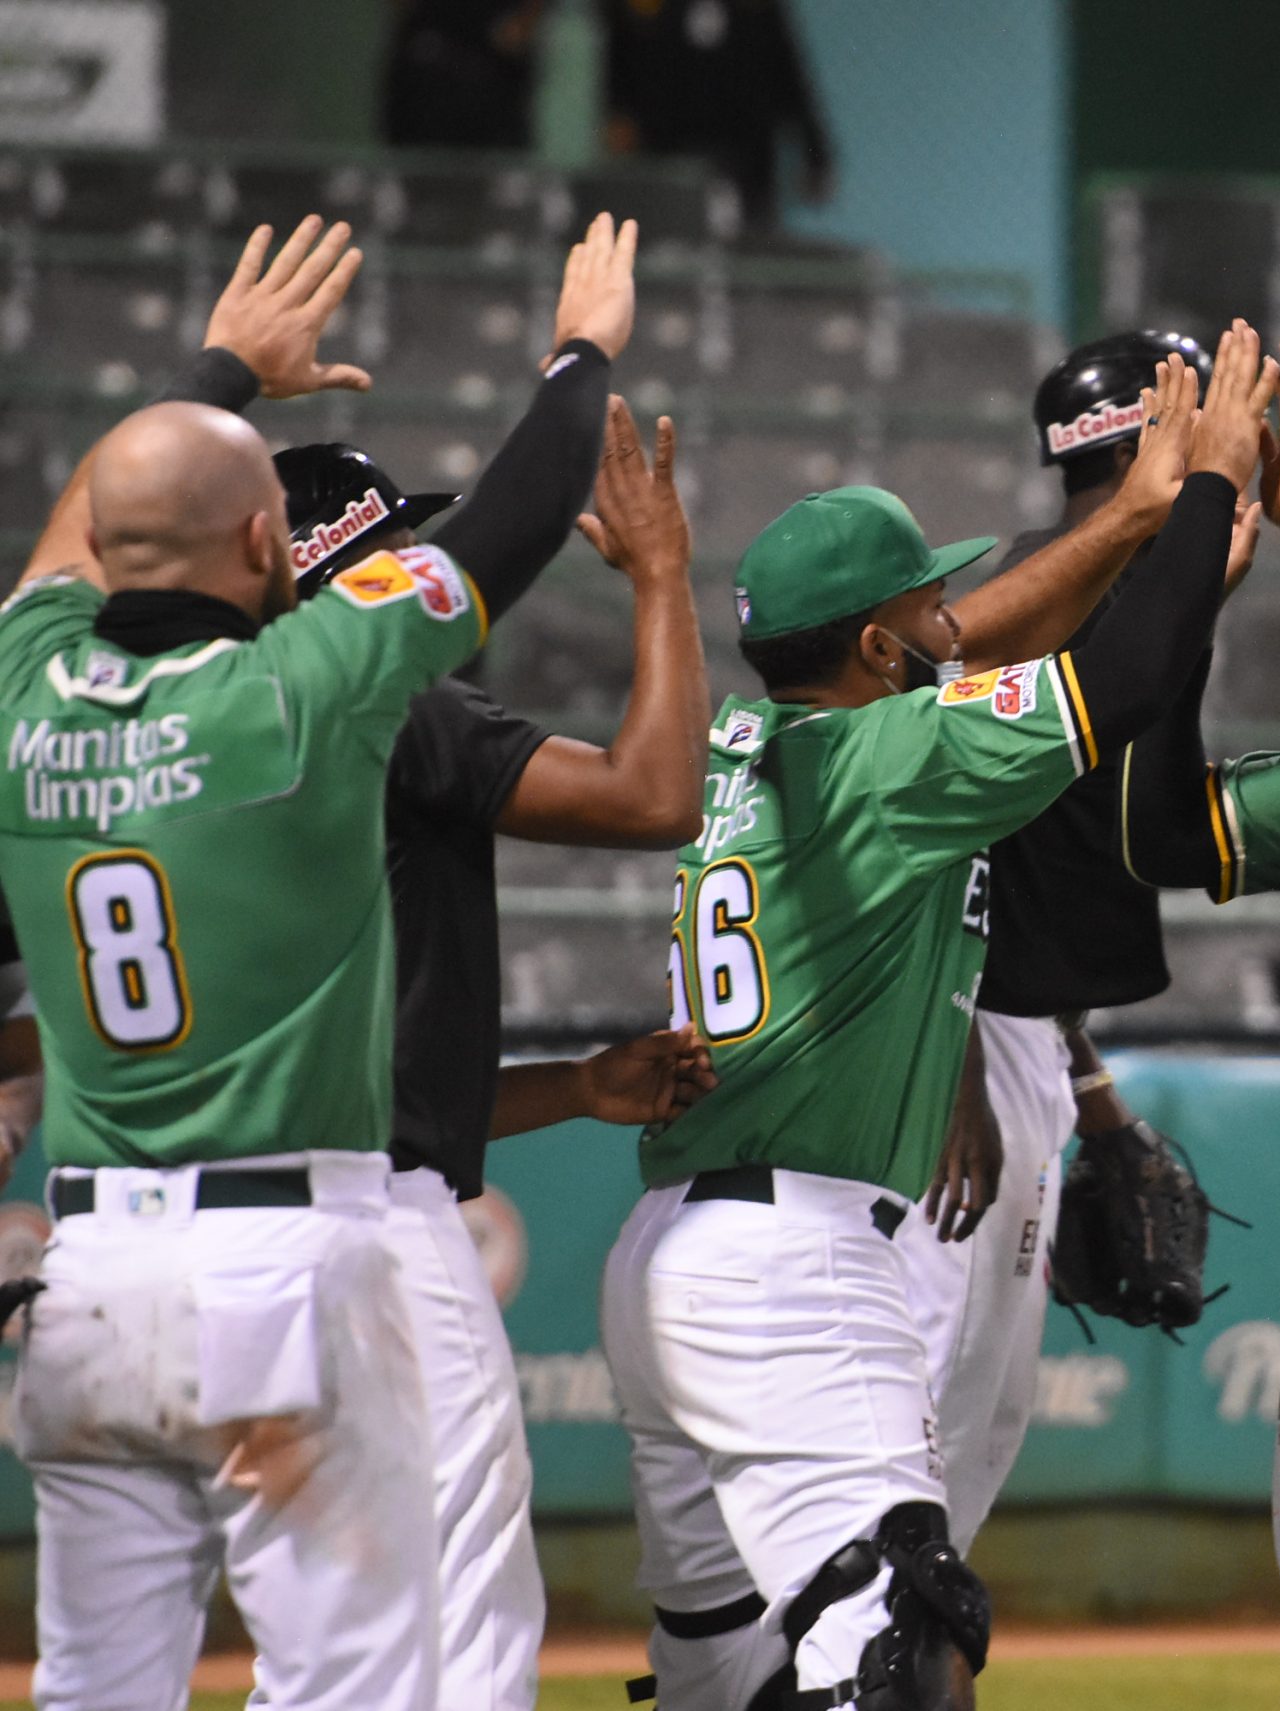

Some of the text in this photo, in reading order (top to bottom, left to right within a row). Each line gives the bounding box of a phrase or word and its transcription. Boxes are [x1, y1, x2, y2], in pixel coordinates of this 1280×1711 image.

[1053, 408, 1143, 448] La Colon
[291, 492, 383, 569] Colonial
[7, 713, 189, 771] Manitas
[25, 754, 203, 832] limpias
[65, 847, 193, 1056] 8
